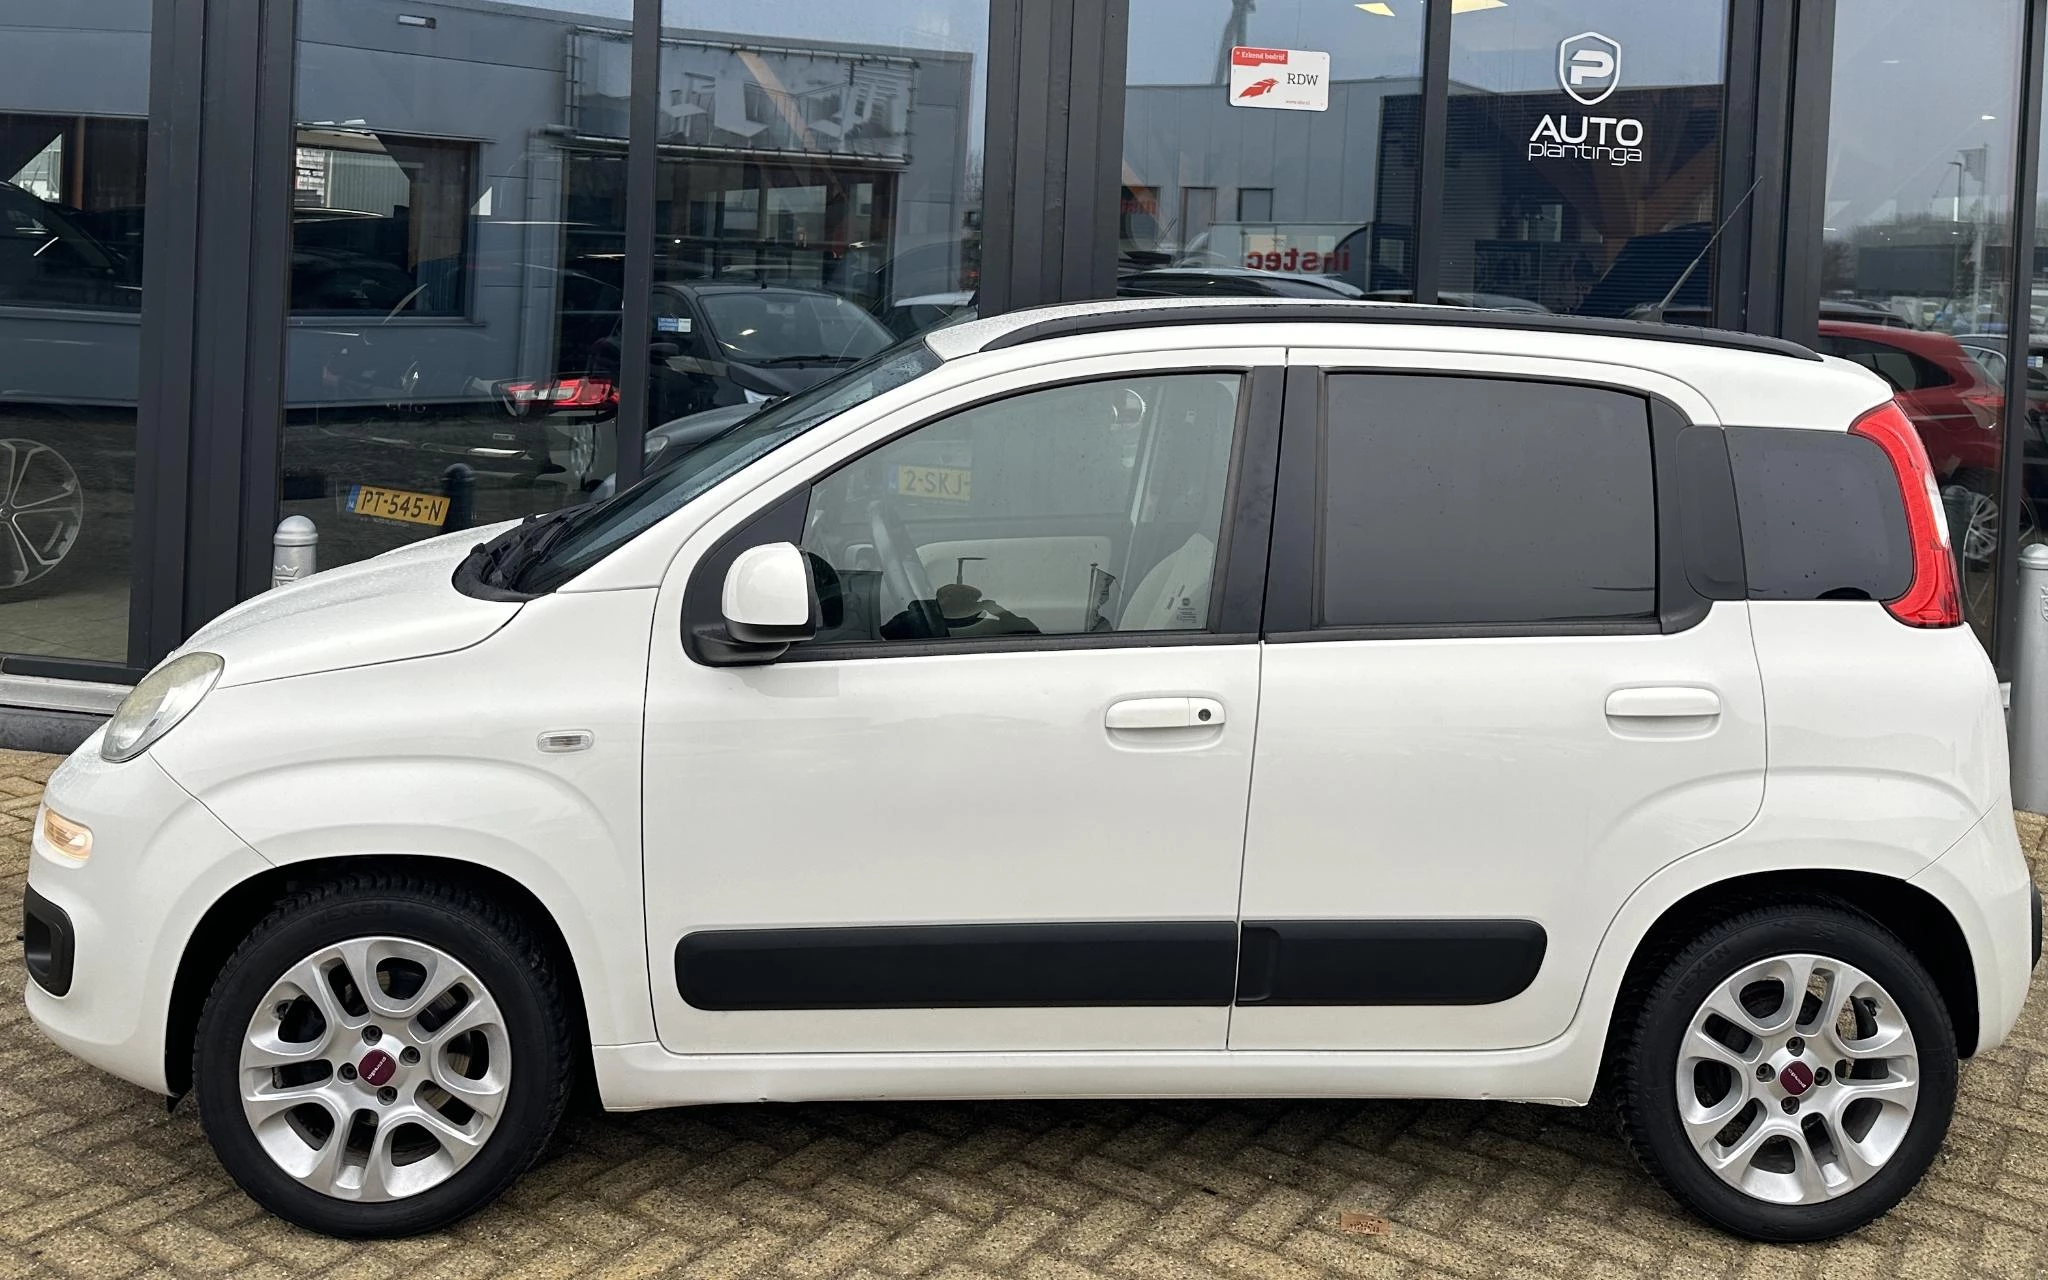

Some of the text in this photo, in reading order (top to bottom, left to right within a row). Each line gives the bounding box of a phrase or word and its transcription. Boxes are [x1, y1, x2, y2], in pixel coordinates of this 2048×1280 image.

[1286, 72, 1319, 87] RDW
[1570, 49, 1615, 85] P
[1529, 114, 1644, 147] AUTO
[1528, 140, 1642, 166] plantinga
[361, 490, 442, 522] PT-545-N
[1672, 944, 1733, 1002] NEXEN
